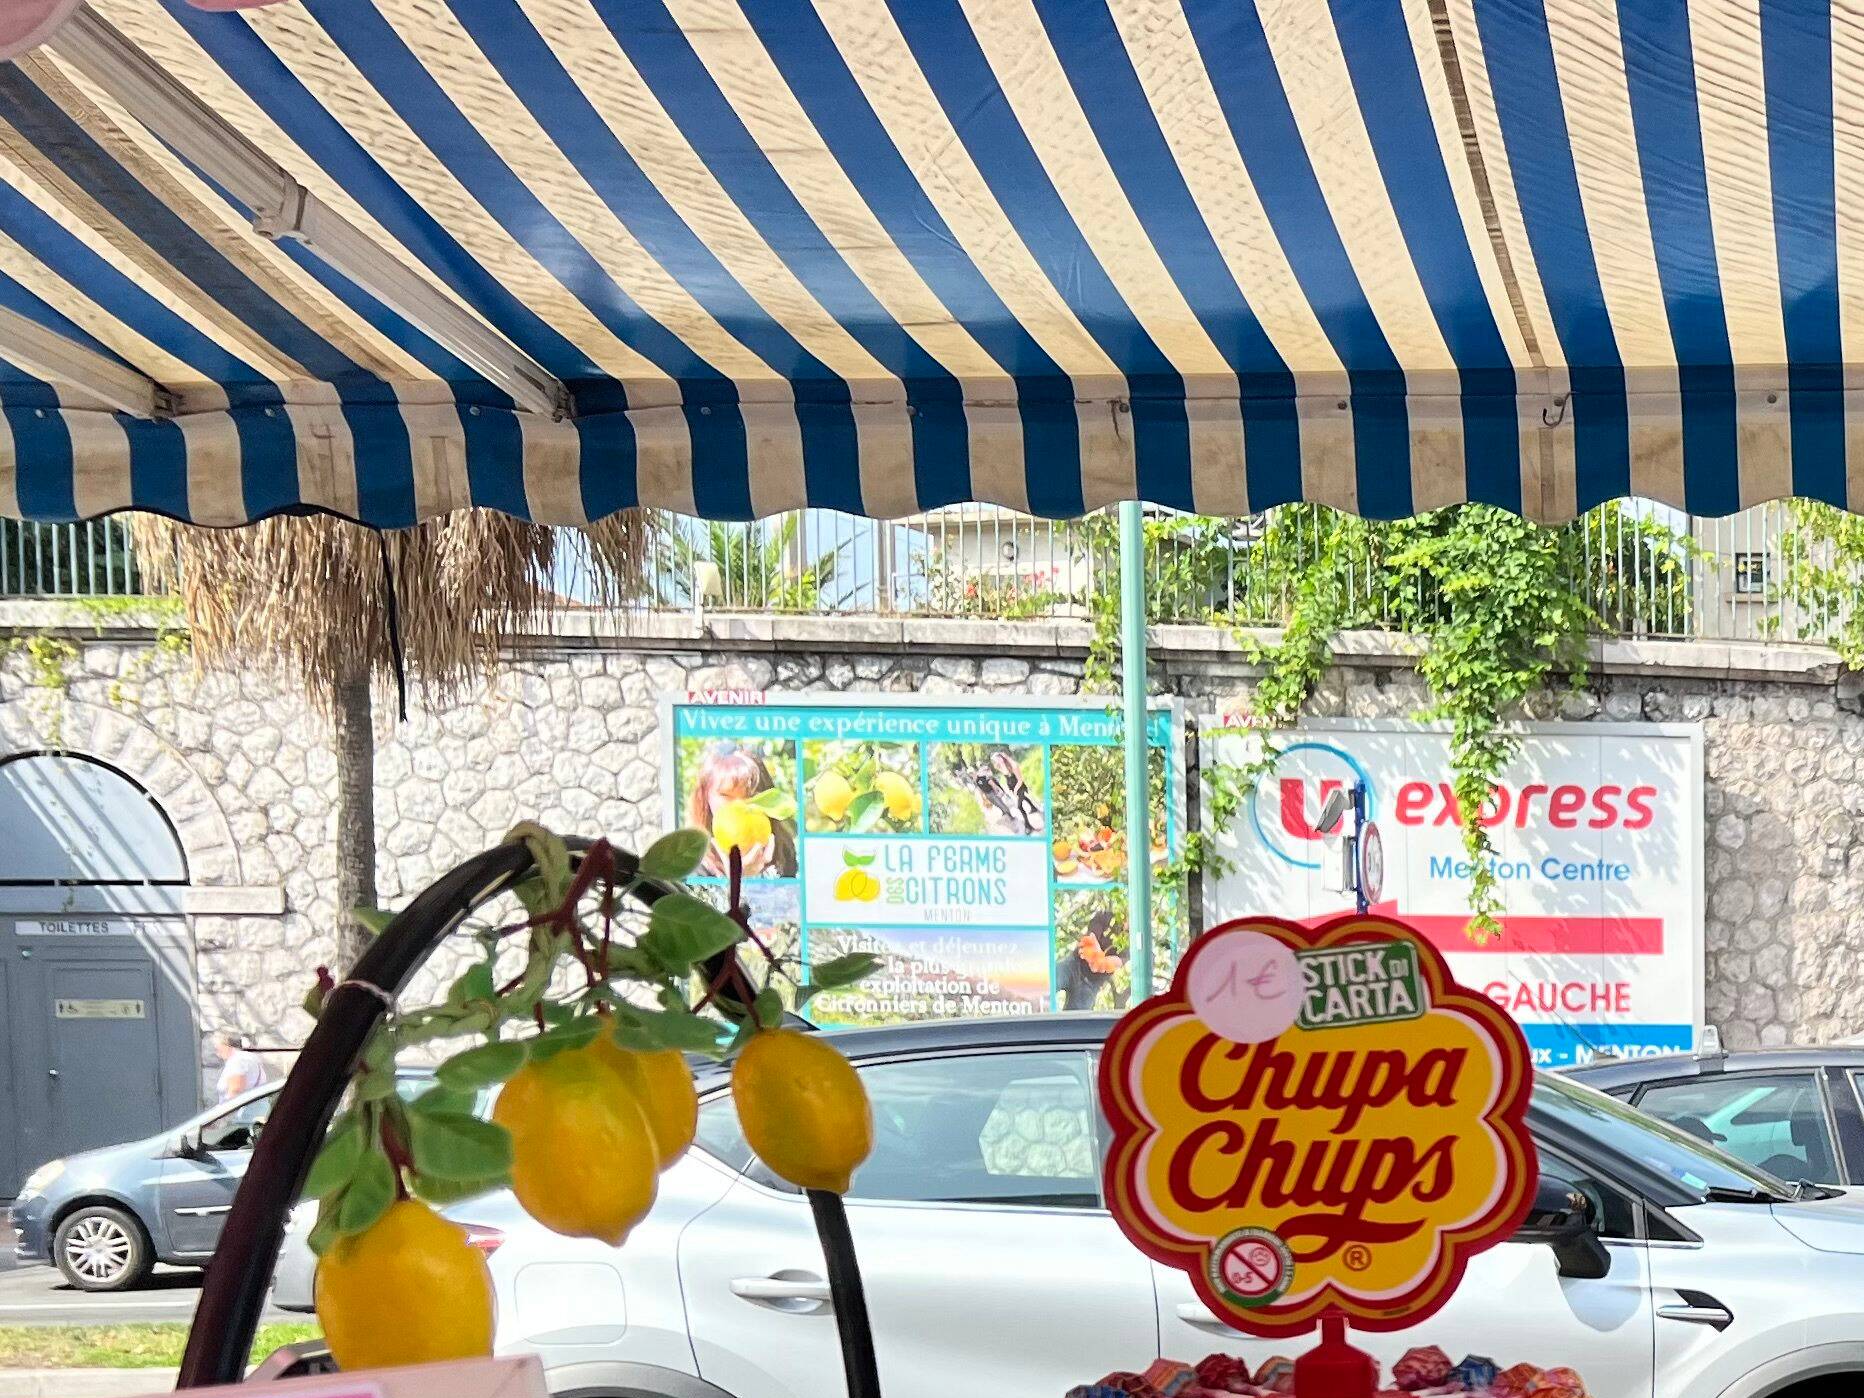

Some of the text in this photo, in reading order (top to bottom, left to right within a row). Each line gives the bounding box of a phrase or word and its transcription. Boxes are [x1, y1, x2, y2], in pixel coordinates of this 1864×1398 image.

[681, 708, 748, 731] Vivez
[755, 717, 800, 731] une
[809, 711, 940, 739] expérience
[947, 713, 1031, 742] unique
[1037, 714, 1050, 736] à
[884, 844, 913, 873] LA
[1429, 856, 1631, 881] Meton Centre
[906, 877, 1007, 906] CITRONS
[39, 921, 109, 933] TOILETTES
[924, 908, 971, 922] MENTON
[1298, 950, 1389, 989] STICK
[814, 992, 928, 1015] Citronniers
[961, 994, 1033, 1017] Menton
[1303, 979, 1417, 1023] CARTA
[1483, 980, 1632, 1013] GAUCHE
[1179, 1034, 1469, 1134] Chupa
[1168, 1117, 1462, 1238] Chups
